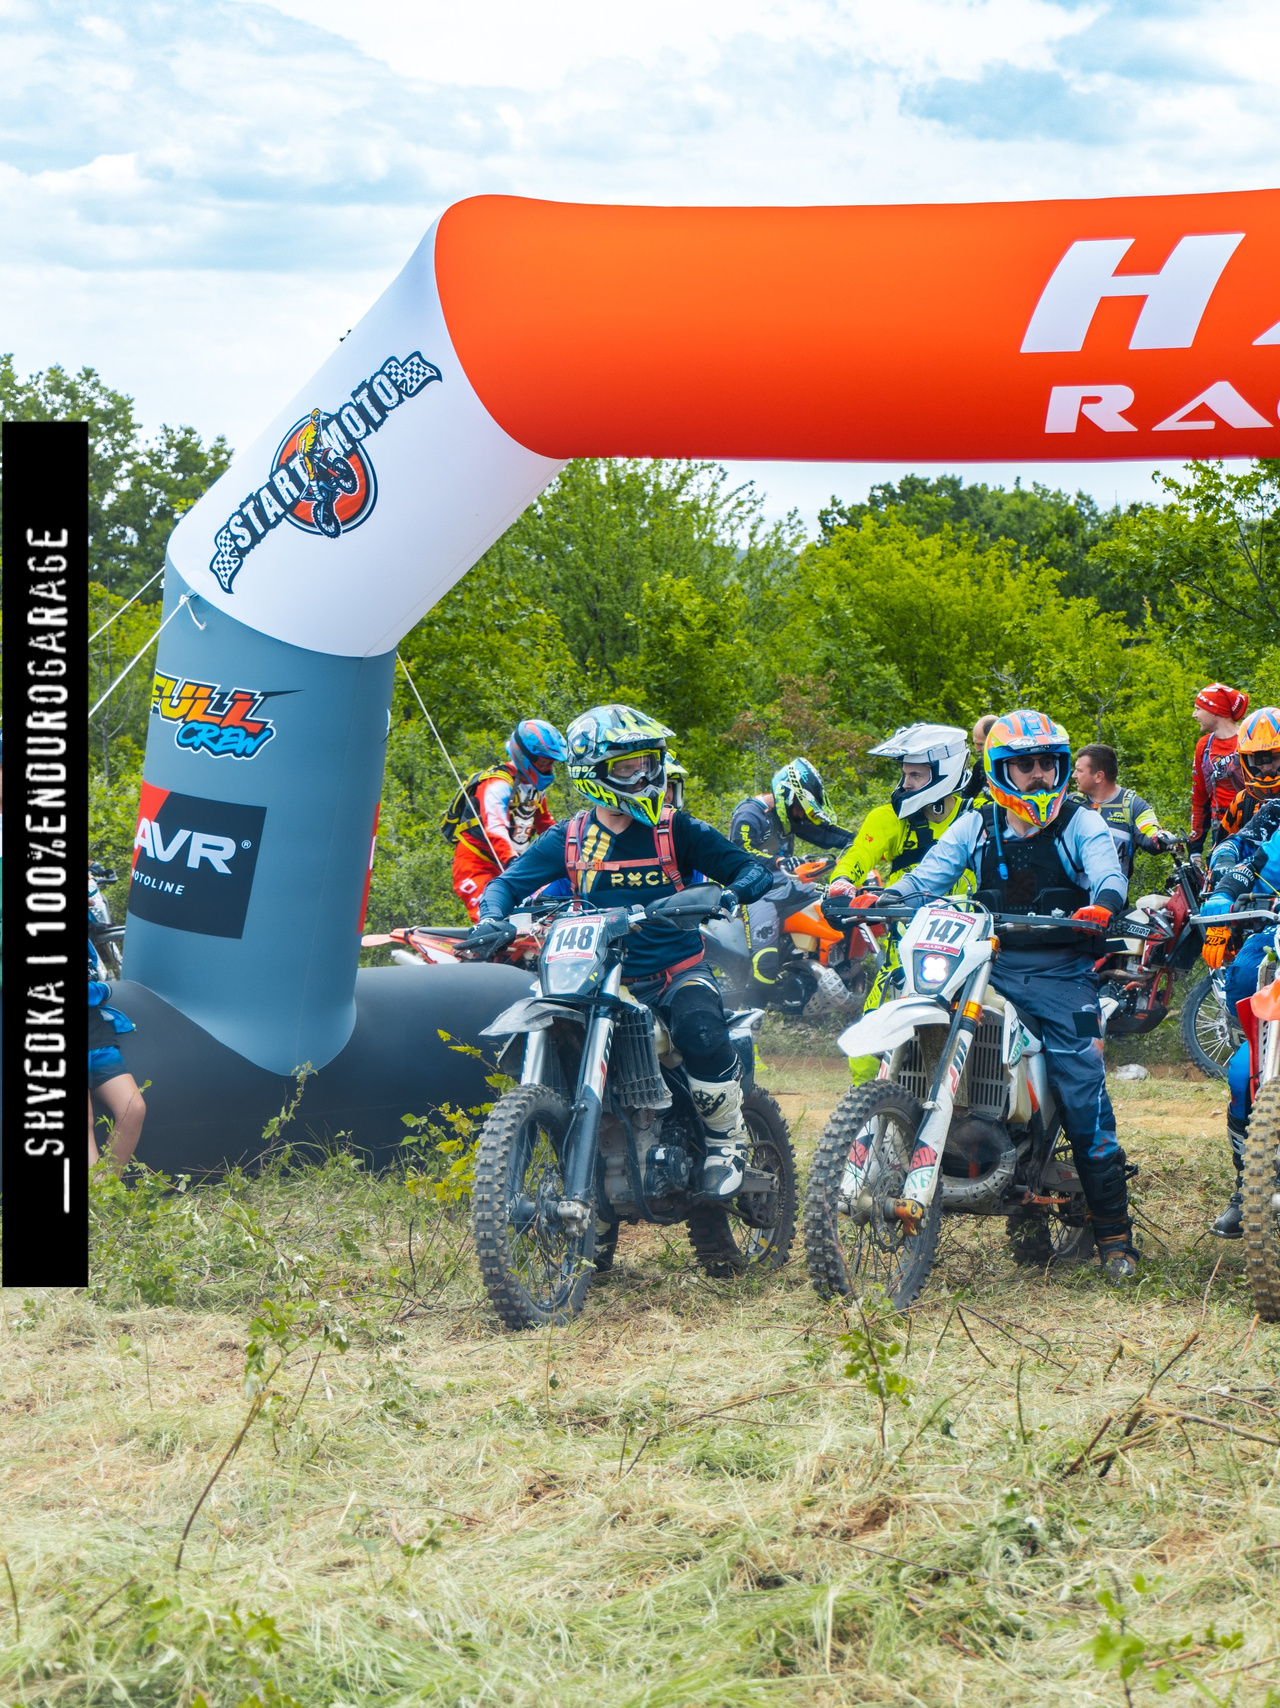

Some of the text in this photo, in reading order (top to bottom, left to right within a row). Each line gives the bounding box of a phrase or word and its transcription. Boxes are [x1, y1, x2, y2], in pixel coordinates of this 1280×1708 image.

[228, 373, 400, 550] START MOTO
[151, 672, 268, 734] FULL
[176, 720, 273, 755] CREW
[1261, 740, 1279, 749] HJC
[135, 817, 237, 875] AVR
[555, 925, 594, 952] 148
[925, 918, 966, 944] 147
